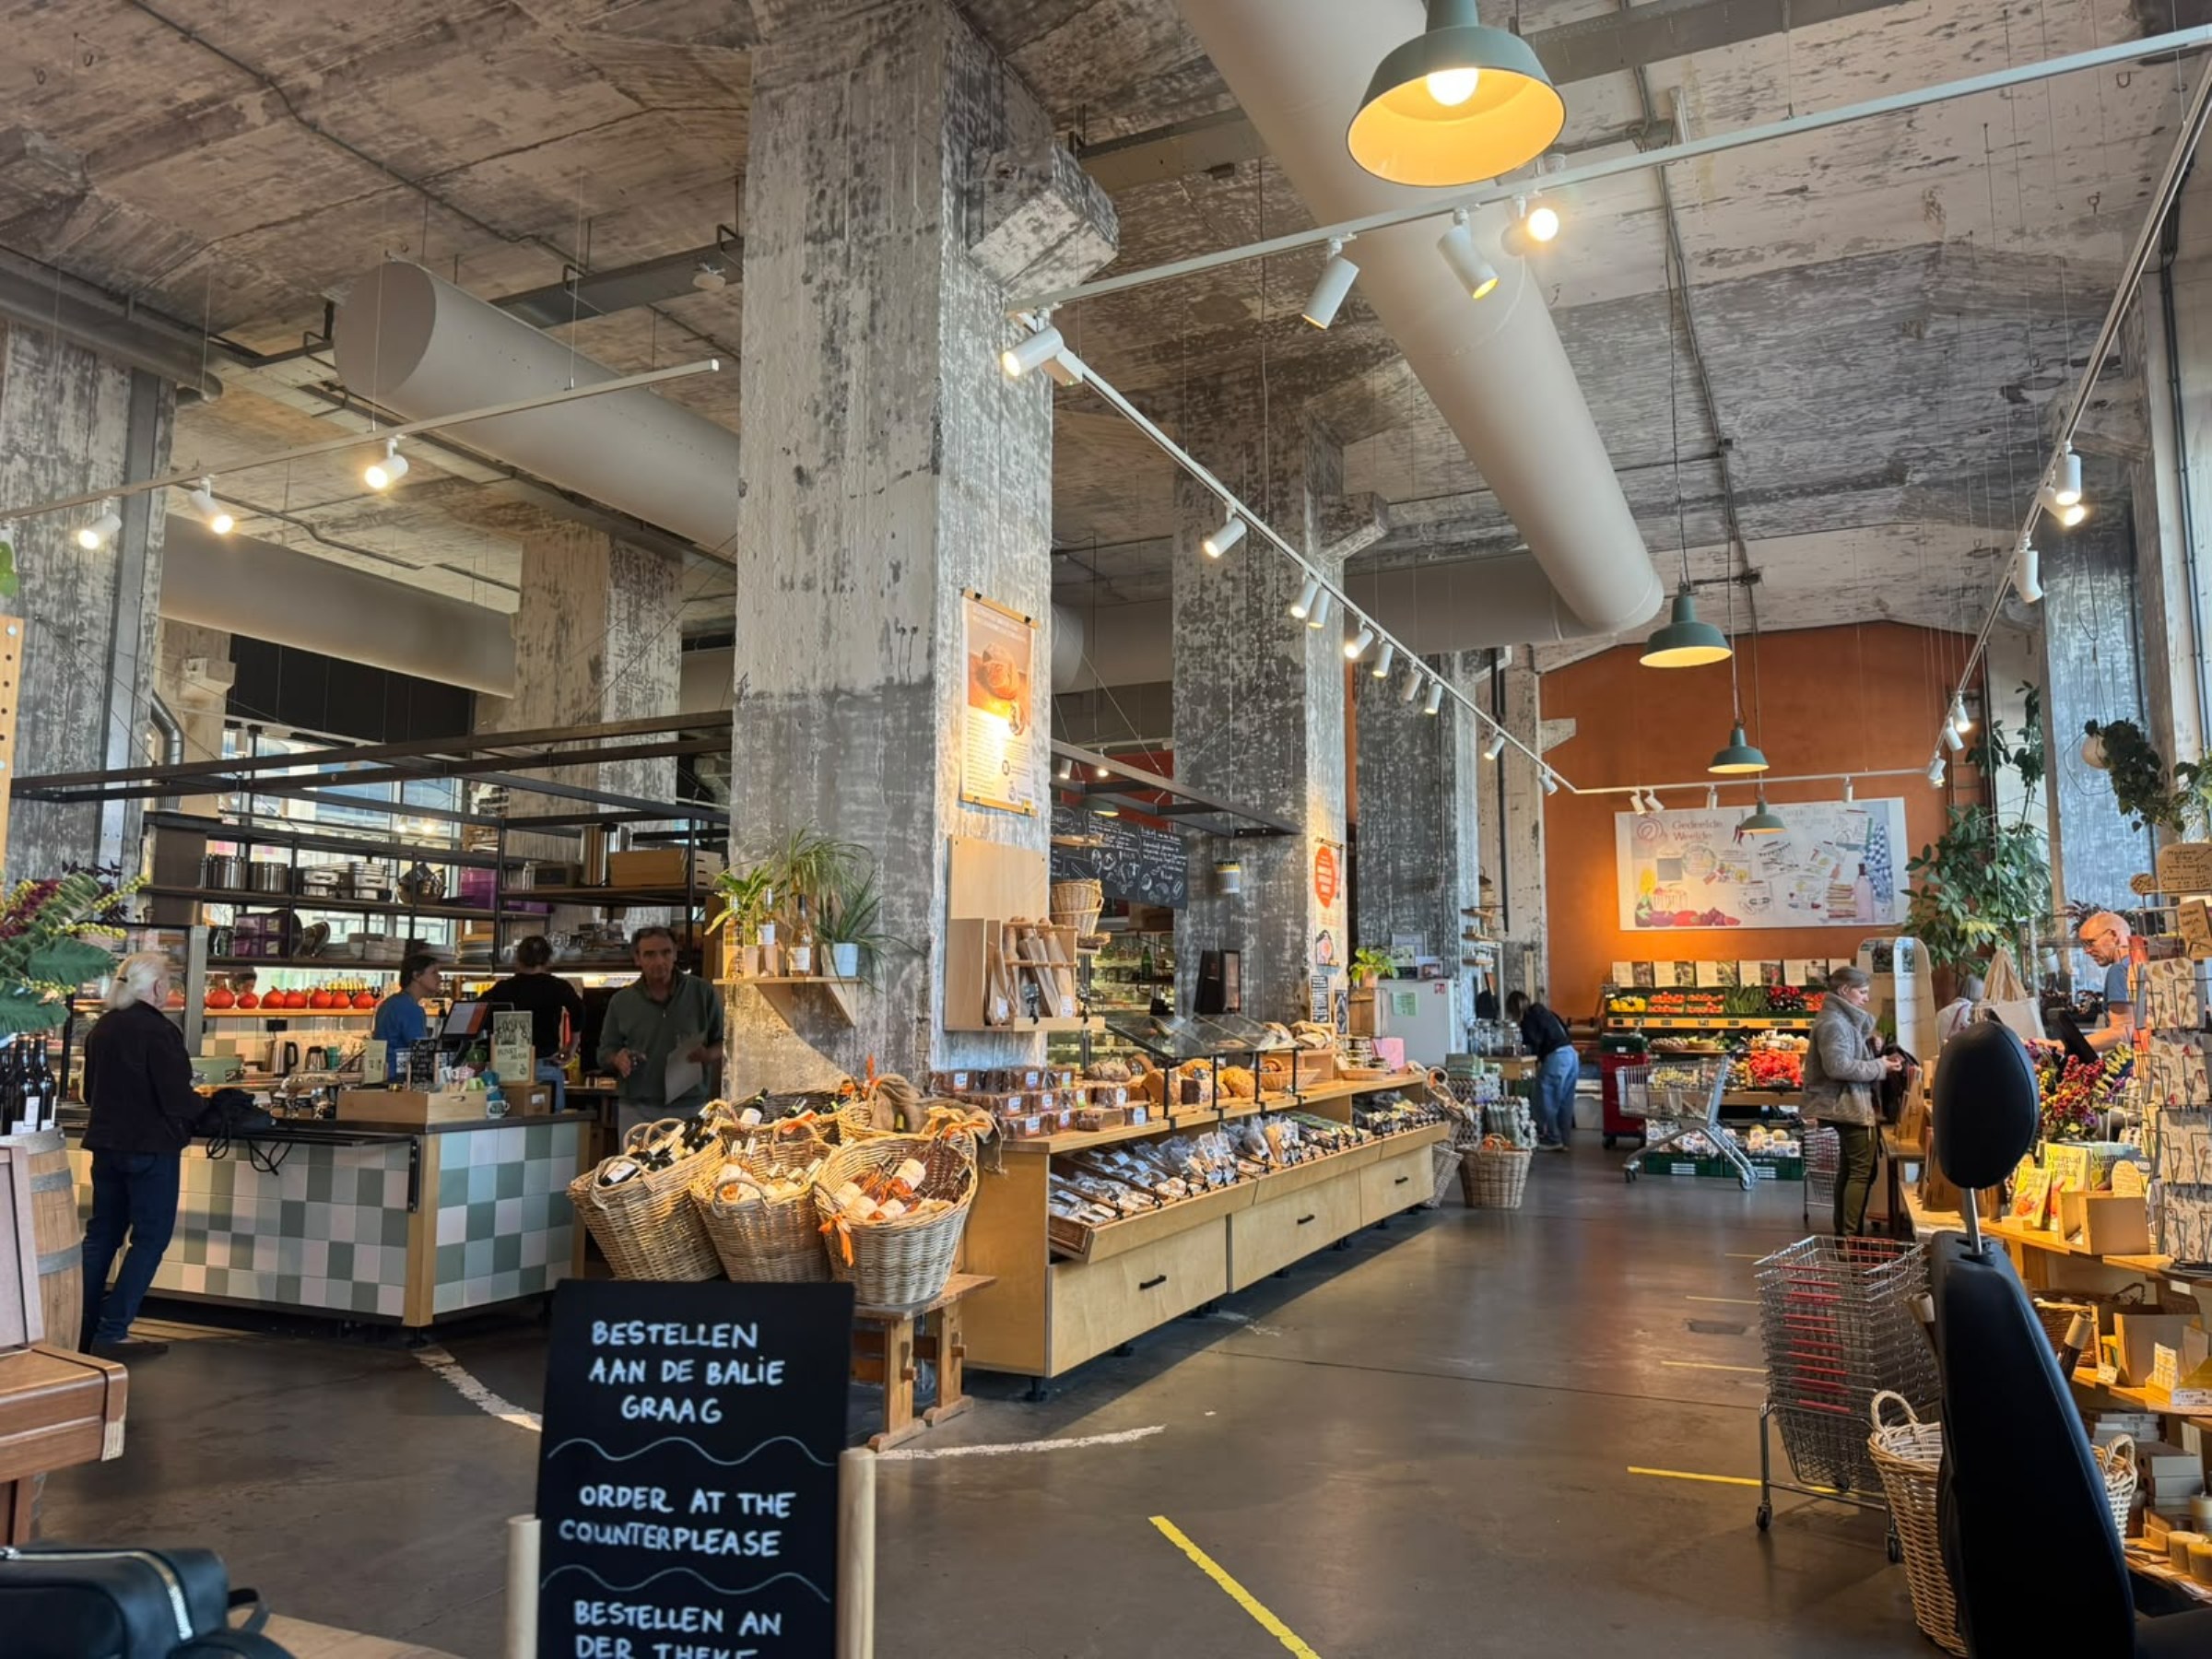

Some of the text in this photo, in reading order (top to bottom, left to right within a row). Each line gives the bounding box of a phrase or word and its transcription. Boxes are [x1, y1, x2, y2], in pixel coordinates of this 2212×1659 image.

[593, 1321, 758, 1348] BESTELLEN
[589, 1358, 646, 1384] AAN
[662, 1359, 694, 1382] DE
[621, 1395, 722, 1423] GRAAG
[580, 1484, 796, 1518] ORDER AT THE
[575, 1600, 781, 1636] BESTELLEN AN
[576, 1635, 633, 1659] DER
